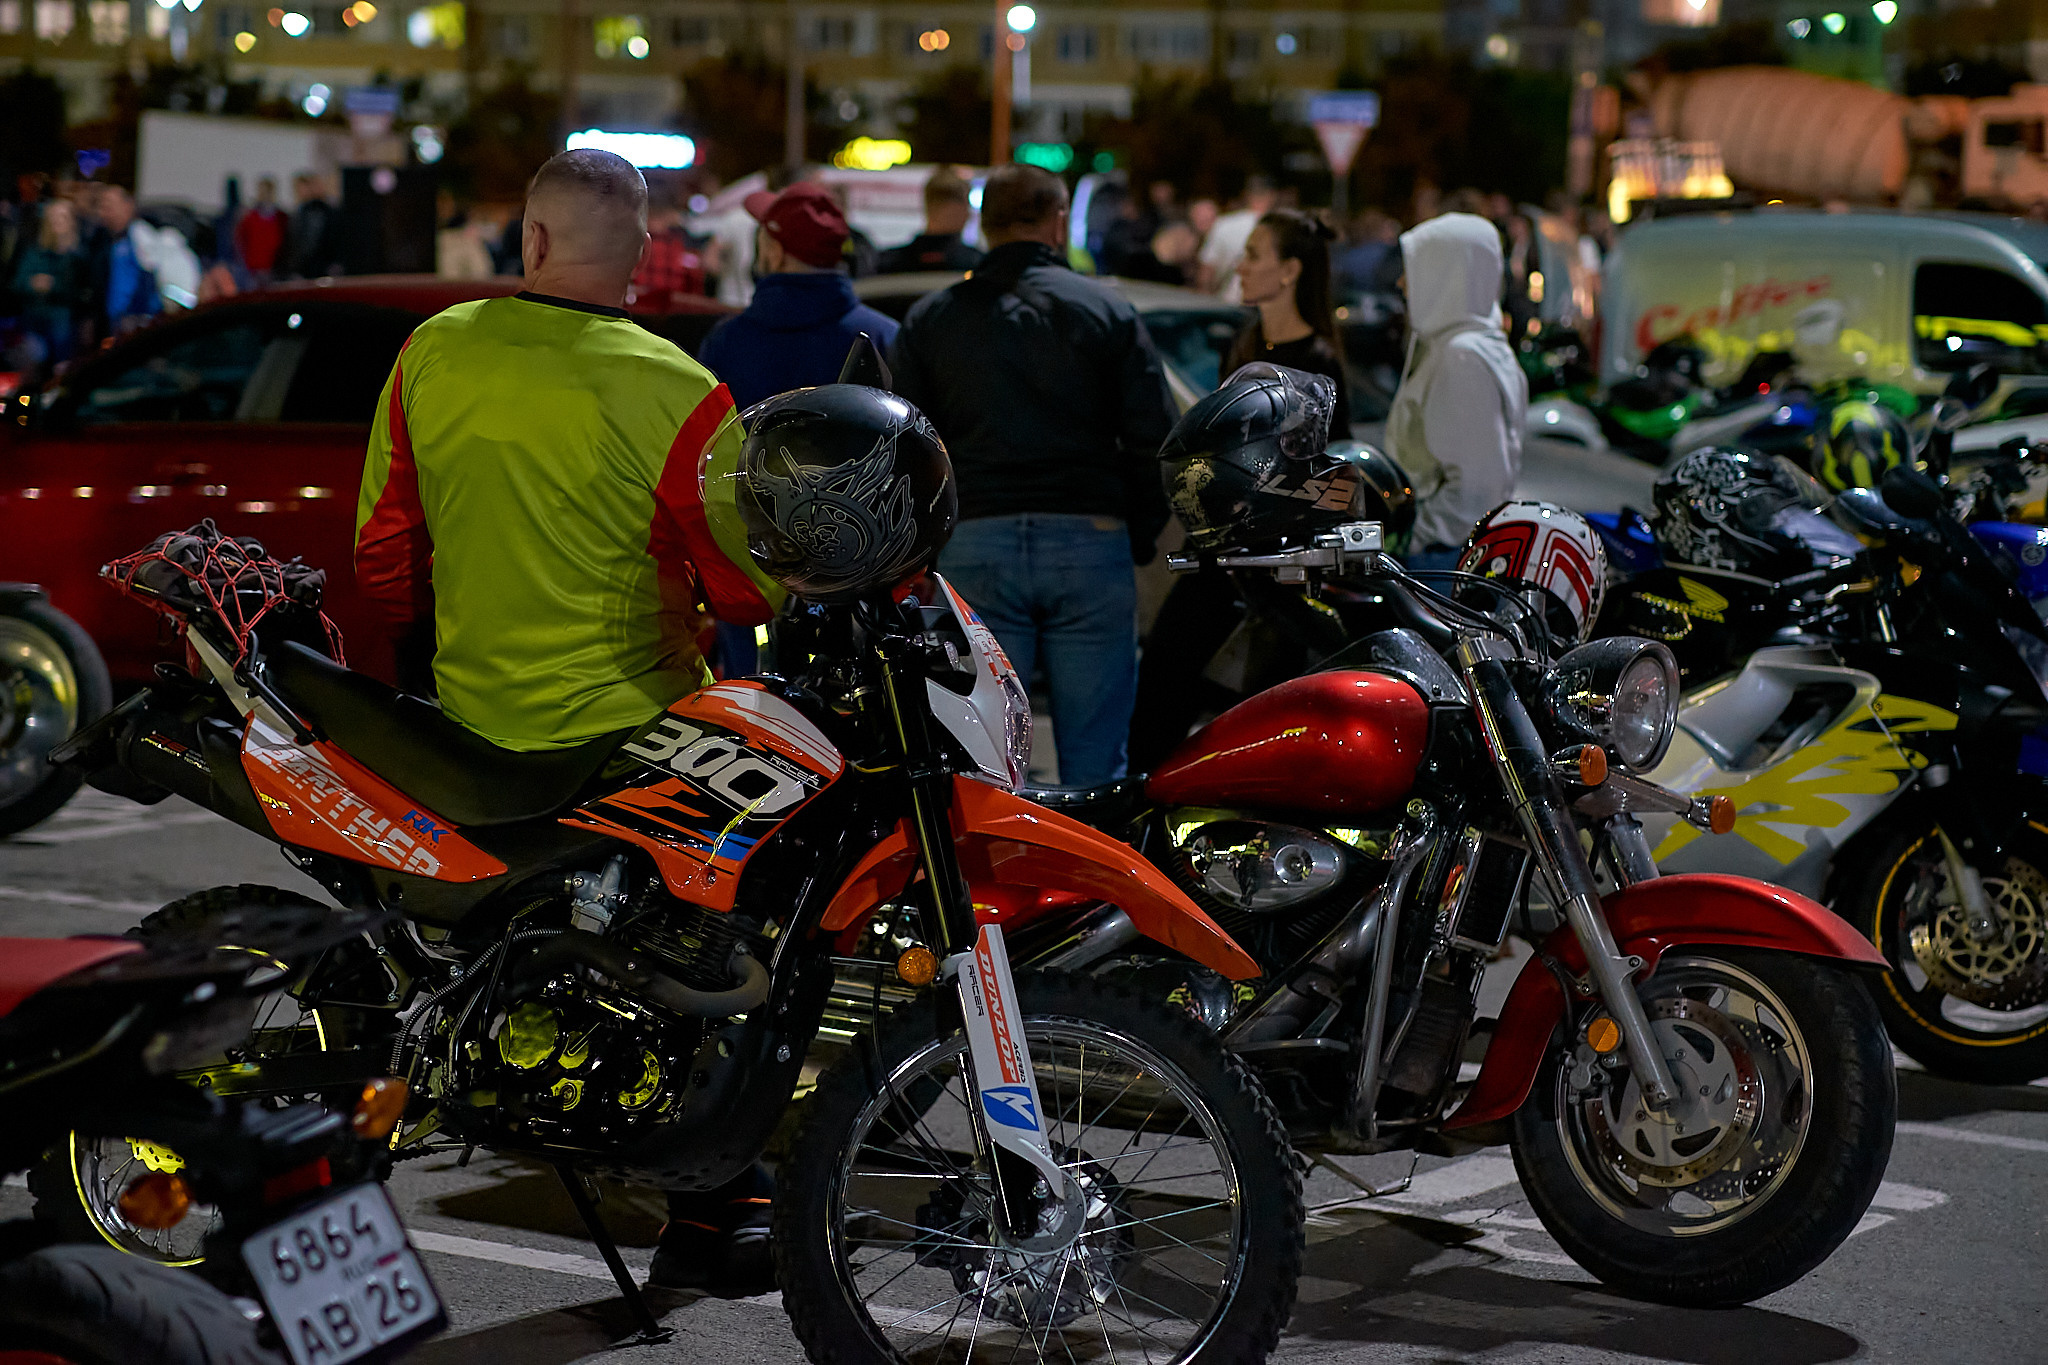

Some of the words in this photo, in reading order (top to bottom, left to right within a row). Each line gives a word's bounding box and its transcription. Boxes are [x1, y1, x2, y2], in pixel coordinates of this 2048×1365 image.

[621, 717, 805, 814] 300
[770, 755, 820, 787] RACER
[247, 744, 440, 877] PANTHER
[401, 809, 451, 844] RK
[967, 964, 985, 1017] RACER
[979, 949, 1018, 1083] DUNLOP
[271, 1203, 380, 1284] 6864
[299, 1301, 359, 1365] AB
[366, 1269, 422, 1327] 26
